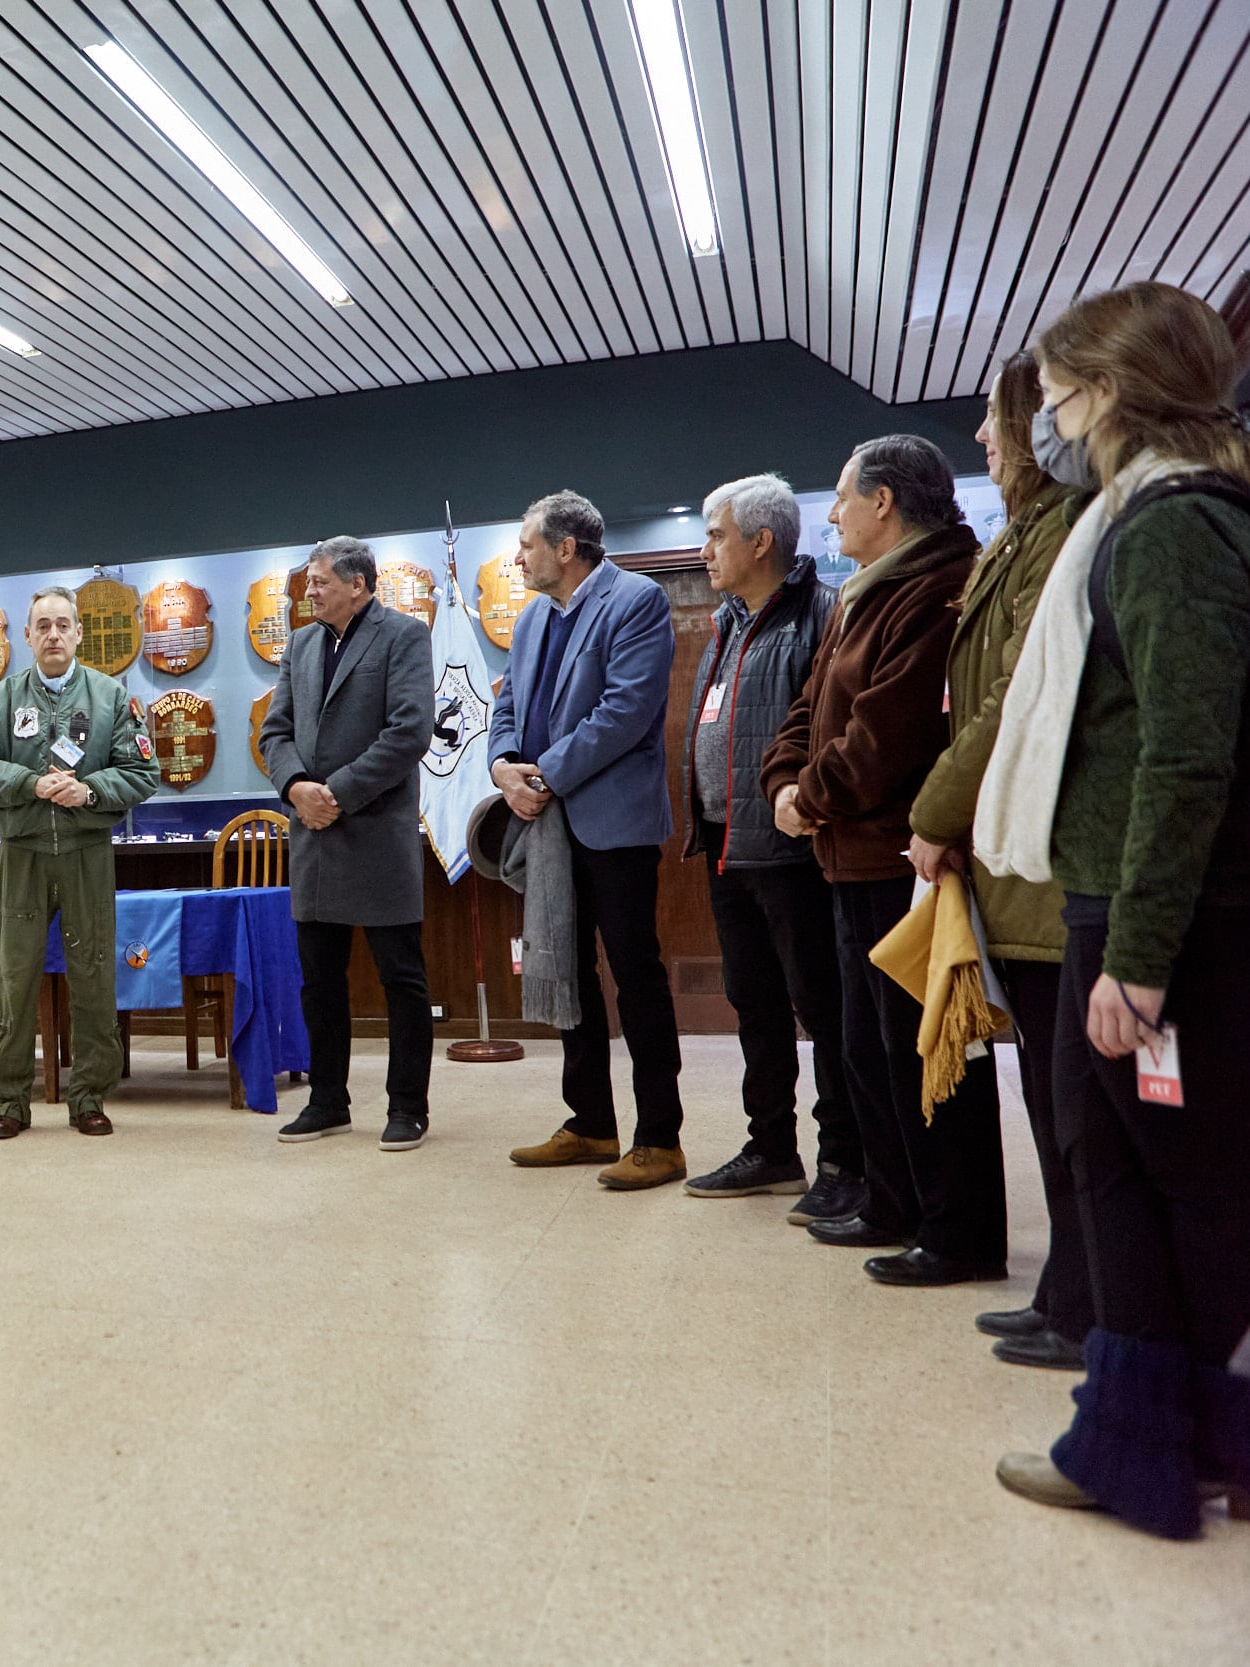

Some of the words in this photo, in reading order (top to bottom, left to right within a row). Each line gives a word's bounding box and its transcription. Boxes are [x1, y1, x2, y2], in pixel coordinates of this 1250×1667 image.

[151, 697, 171, 714] GRUPO
[178, 692, 187, 700] DE
[187, 696, 205, 710] CAZA
[157, 700, 198, 717] BOMBARDEO
